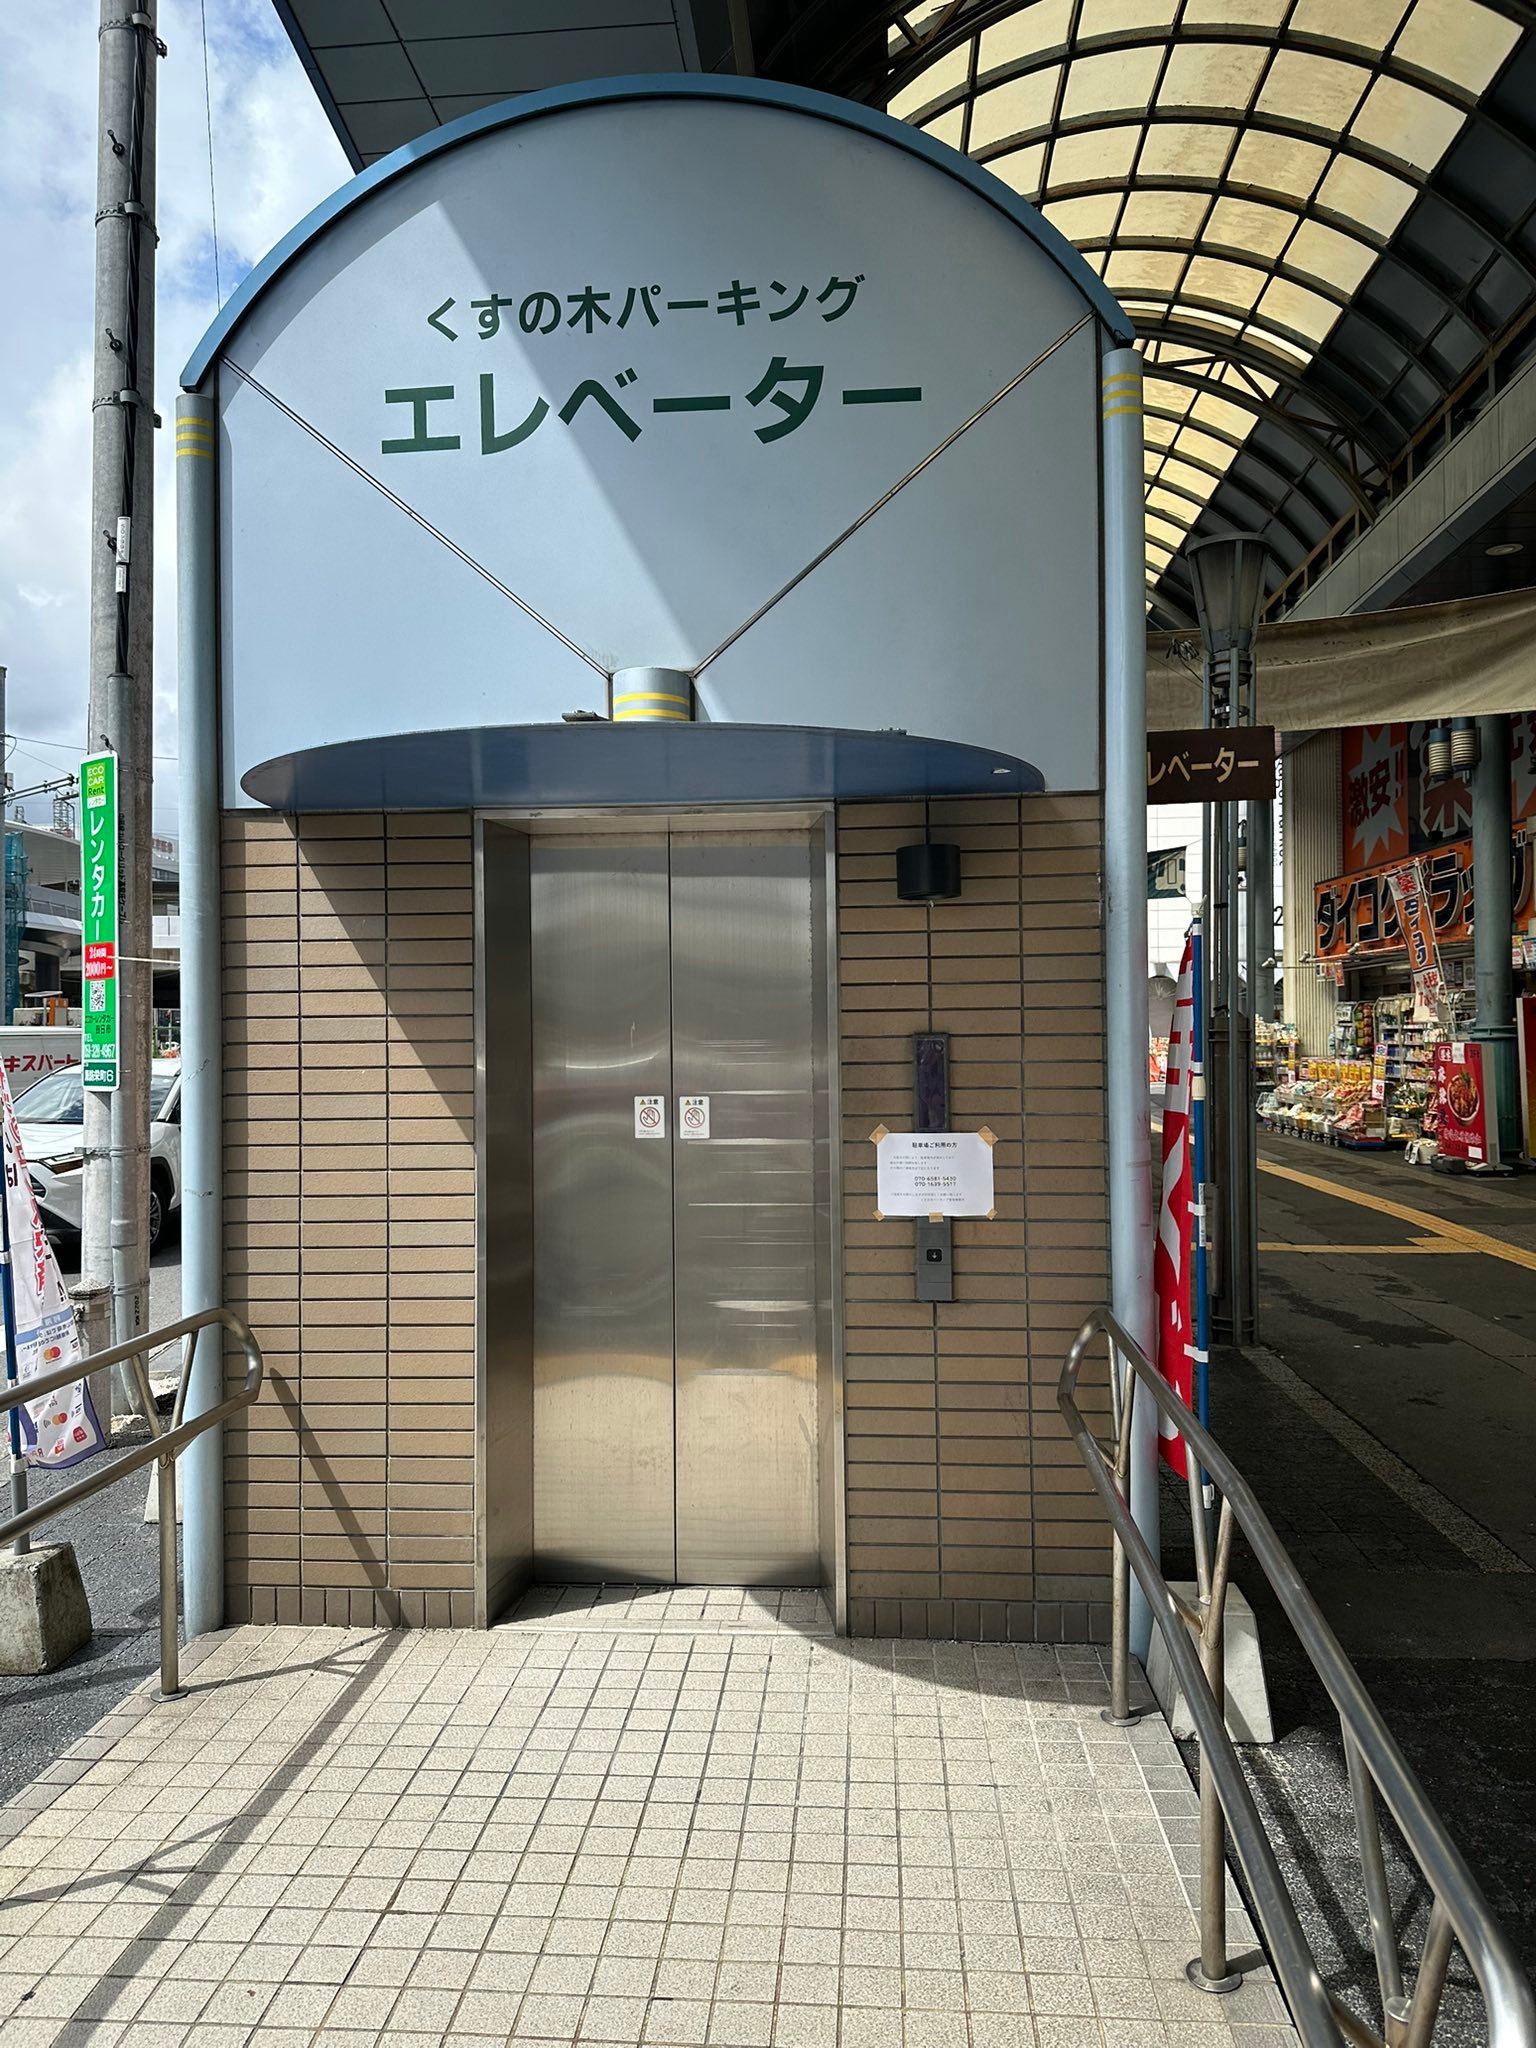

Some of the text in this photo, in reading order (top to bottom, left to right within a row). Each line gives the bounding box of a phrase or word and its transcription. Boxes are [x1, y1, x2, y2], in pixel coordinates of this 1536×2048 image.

[427, 273, 866, 341] くすの木パーキング
[381, 356, 922, 455] エレベーター
[88, 765, 105, 776] ECO
[1147, 747, 1259, 786] レベーター
[88, 776, 105, 786] CAR
[88, 786, 105, 796] Rent
[90, 810, 105, 941] レンタカー
[89, 946, 107, 959] 24時間
[4, 1054, 80, 1073] キスパート
